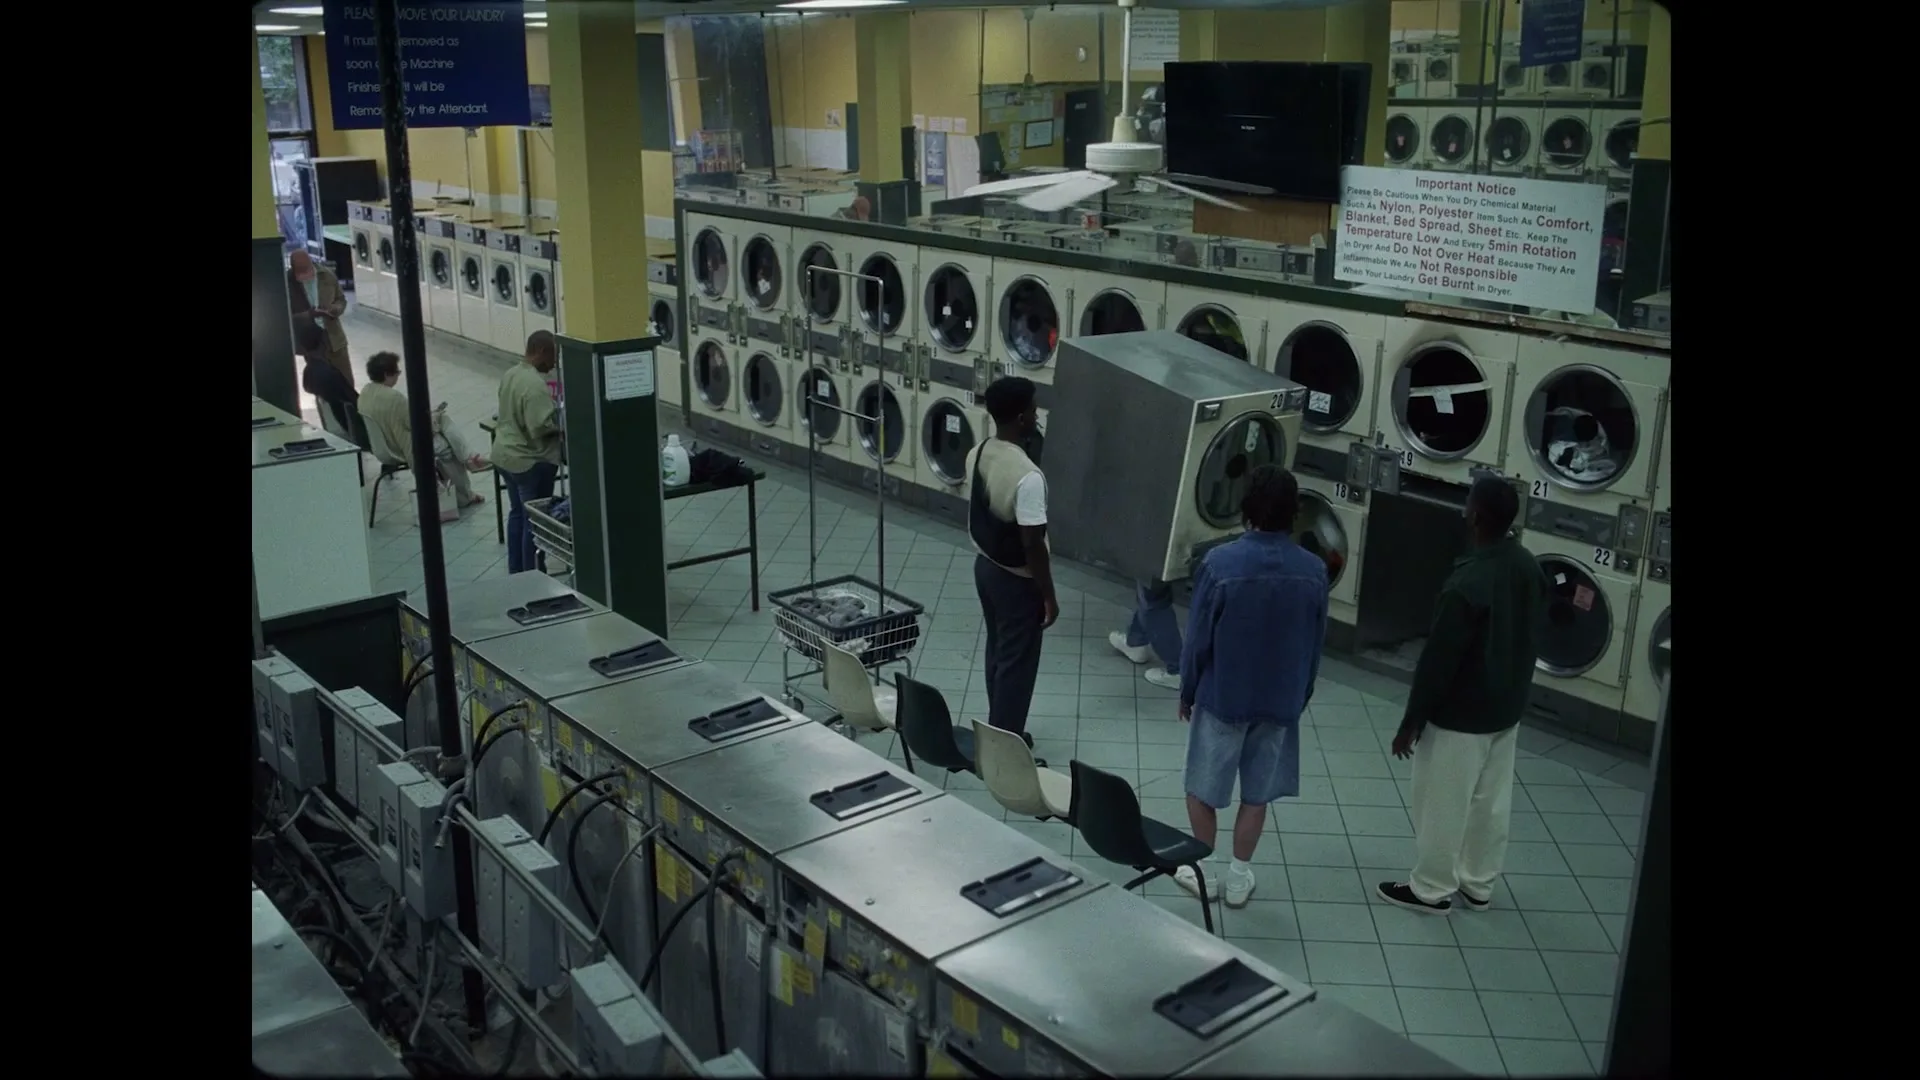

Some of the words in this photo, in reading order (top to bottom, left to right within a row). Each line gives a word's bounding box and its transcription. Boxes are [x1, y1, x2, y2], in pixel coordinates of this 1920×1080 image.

[344, 7, 375, 20] PLEAS
[431, 8, 458, 21] YOUR
[460, 8, 505, 22] LAUNDRY
[446, 37, 459, 47] as
[346, 60, 372, 69] soon
[410, 58, 455, 69] Machine
[413, 81, 428, 92] will
[430, 81, 445, 92] be
[419, 104, 435, 115] the
[1415, 176, 1472, 192] Important
[1477, 181, 1516, 196] Notice
[1347, 186, 1370, 196] Please
[1373, 188, 1383, 197] Be
[1385, 190, 1419, 201] Cautious
[1421, 193, 1443, 202] When
[1446, 195, 1460, 204] You
[1463, 196, 1477, 207] Dry
[1480, 198, 1519, 209] Chemical
[1521, 202, 1556, 213] Material
[1346, 199, 1365, 209] Such
[1367, 201, 1376, 210] As
[1380, 200, 1415, 214] Nylon,
[1419, 203, 1474, 219] Polyester
[1497, 214, 1518, 225] Such
[1521, 216, 1532, 225] As
[1536, 215, 1593, 233] Comfort,
[1346, 210, 1389, 226] Blanket,
[1393, 215, 1415, 228] Bed
[1419, 217, 1463, 234] Spread,
[1468, 222, 1502, 237] Sheet
[1527, 231, 1549, 242] Keep
[1552, 234, 1568, 244] The
[1345, 223, 1413, 241] Temperature
[1417, 231, 1440, 244] Low
[1443, 237, 1459, 246] And
[1462, 239, 1484, 250] Every
[1488, 239, 1517, 253] 5min
[1522, 243, 1576, 260] Rotation
[1353, 241, 1373, 251] Dryer
[1375, 244, 1390, 252] And
[1393, 242, 1408, 255] Do
[1412, 245, 1432, 257] Not
[1436, 247, 1463, 260] Over
[1467, 251, 1495, 265] Heat
[1498, 257, 1534, 270] Because
[1536, 262, 1558, 275] They
[1560, 265, 1575, 275] Are
[1343, 253, 1388, 265] Inflammable
[1390, 258, 1402, 267] We
[1404, 260, 1417, 269] Are
[1420, 260, 1440, 272] Not
[1444, 262, 1518, 282] Responsible
[1342, 266, 1363, 275] When
[1366, 268, 1381, 278] Your
[1384, 271, 1415, 283] Laundry
[1418, 273, 1438, 285] Get
[1441, 276, 1474, 290] Burnt
[1487, 284, 1512, 296] Dryer.
[1270, 394, 1284, 408] 20
[1335, 483, 1347, 498] 18
[1533, 480, 1548, 497] 21
[1594, 548, 1610, 566] 22
